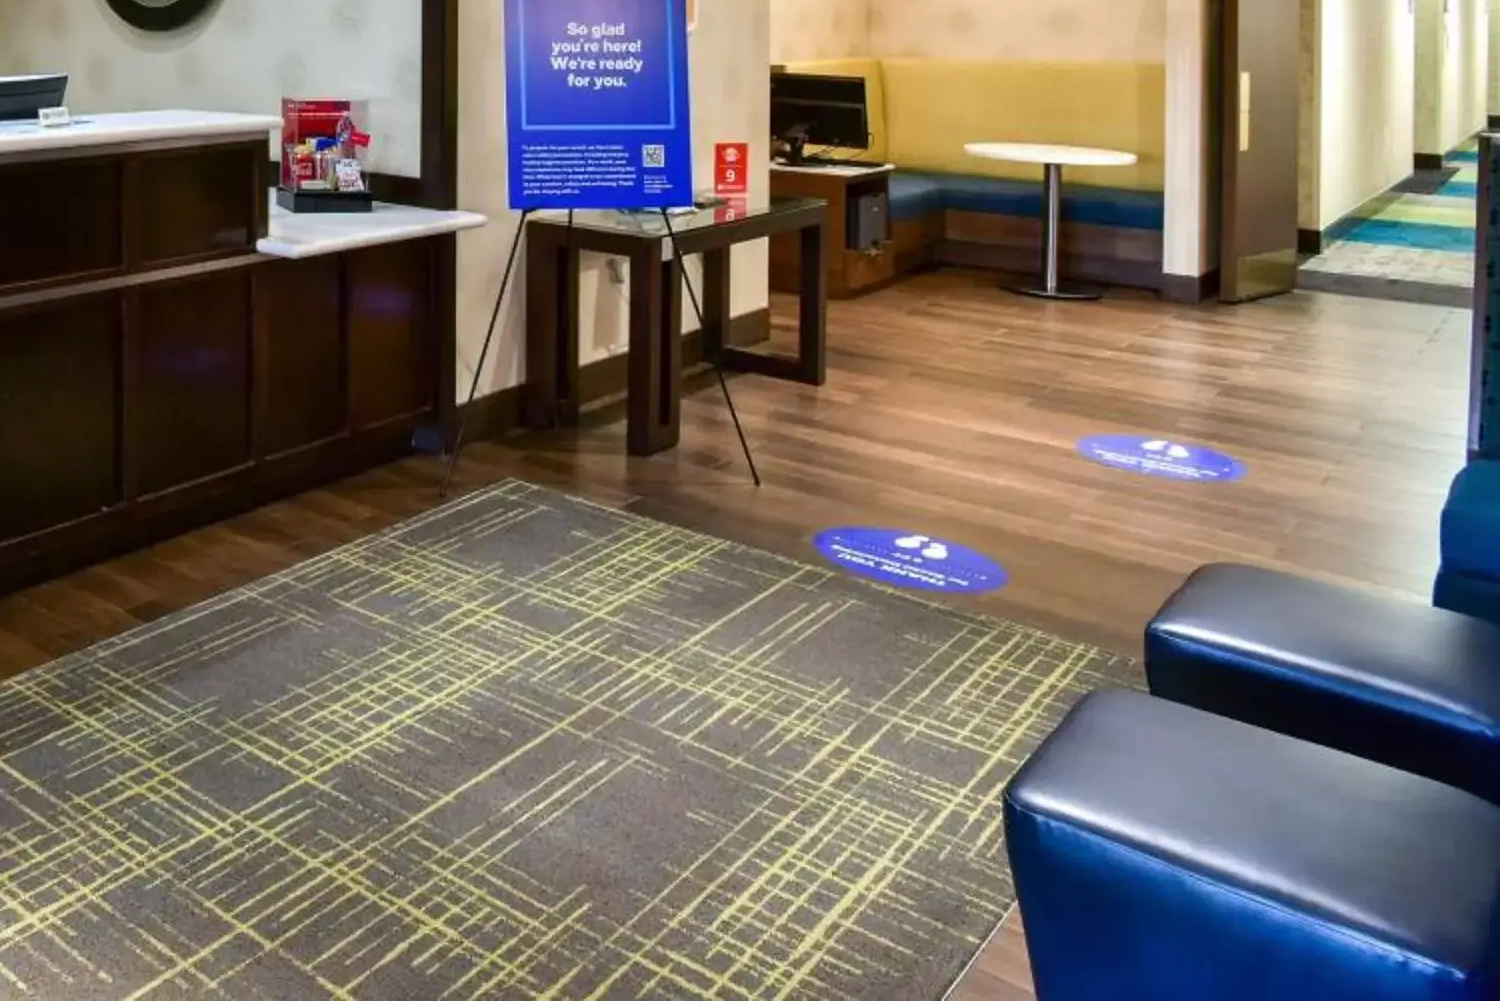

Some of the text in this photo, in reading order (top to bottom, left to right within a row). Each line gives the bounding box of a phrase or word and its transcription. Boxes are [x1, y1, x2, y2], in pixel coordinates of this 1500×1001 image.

[567, 22, 625, 39] So glad
[551, 39, 642, 56] you're here!
[550, 57, 643, 73] We're ready
[567, 73, 627, 90] for you.
